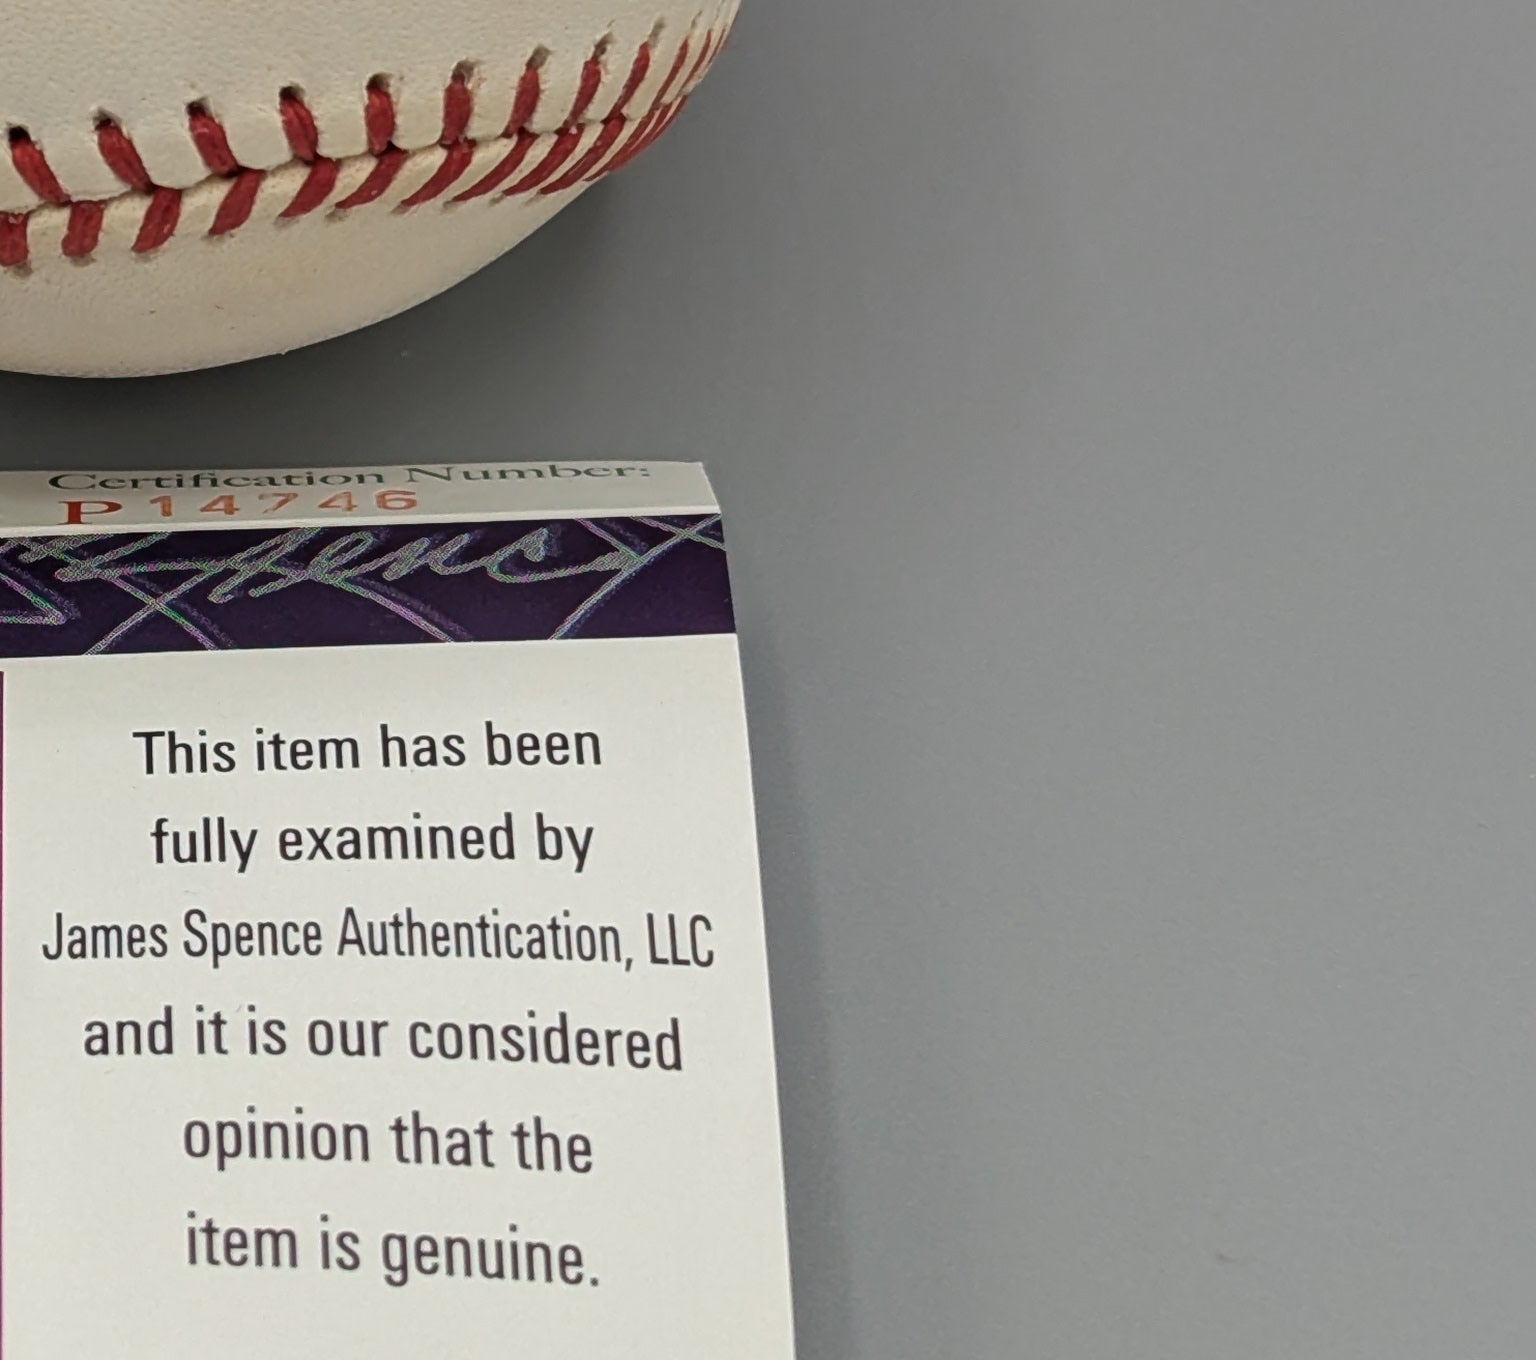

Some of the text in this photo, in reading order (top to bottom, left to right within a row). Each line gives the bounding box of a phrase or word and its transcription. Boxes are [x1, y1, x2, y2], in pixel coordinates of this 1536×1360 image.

[48, 465, 650, 490] Certification Number:
[133, 720, 602, 775] This item has been
[151, 812, 594, 873] fully examined by
[42, 907, 714, 972] James Spence Authentication, LLC
[83, 1004, 683, 1072] and it is our considered
[183, 1104, 594, 1175] opinion that the
[186, 1210, 599, 1288] item is genuine.
